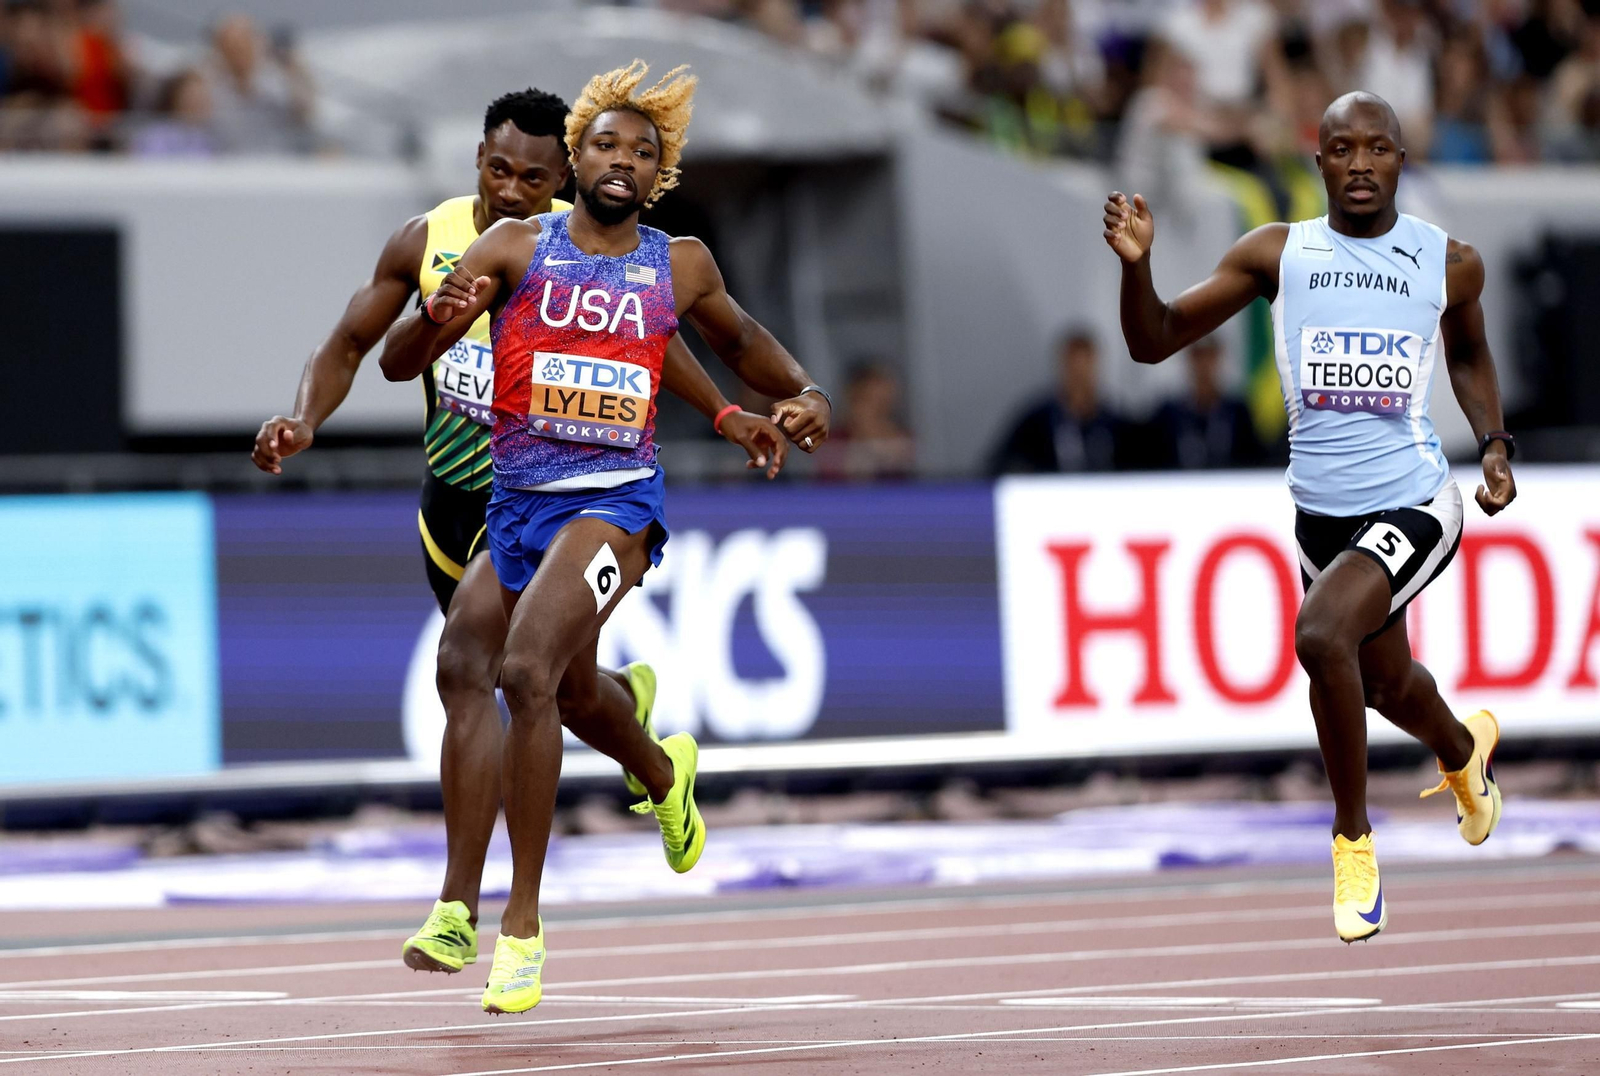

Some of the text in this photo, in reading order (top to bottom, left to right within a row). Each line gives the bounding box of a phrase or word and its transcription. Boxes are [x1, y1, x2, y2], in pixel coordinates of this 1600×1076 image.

[1308, 271, 1410, 298] BOTSWANA
[540, 280, 645, 340] USA
[1334, 331, 1413, 359] TDK
[444, 367, 495, 402] LEV
[566, 359, 643, 394] TDK
[1307, 362, 1413, 389] TEBOGO
[543, 387, 637, 423] LYLES
[1375, 530, 1402, 557] 5
[597, 565, 617, 595] 6
[1046, 529, 1600, 709] HOD
[0, 600, 173, 717] TICS
